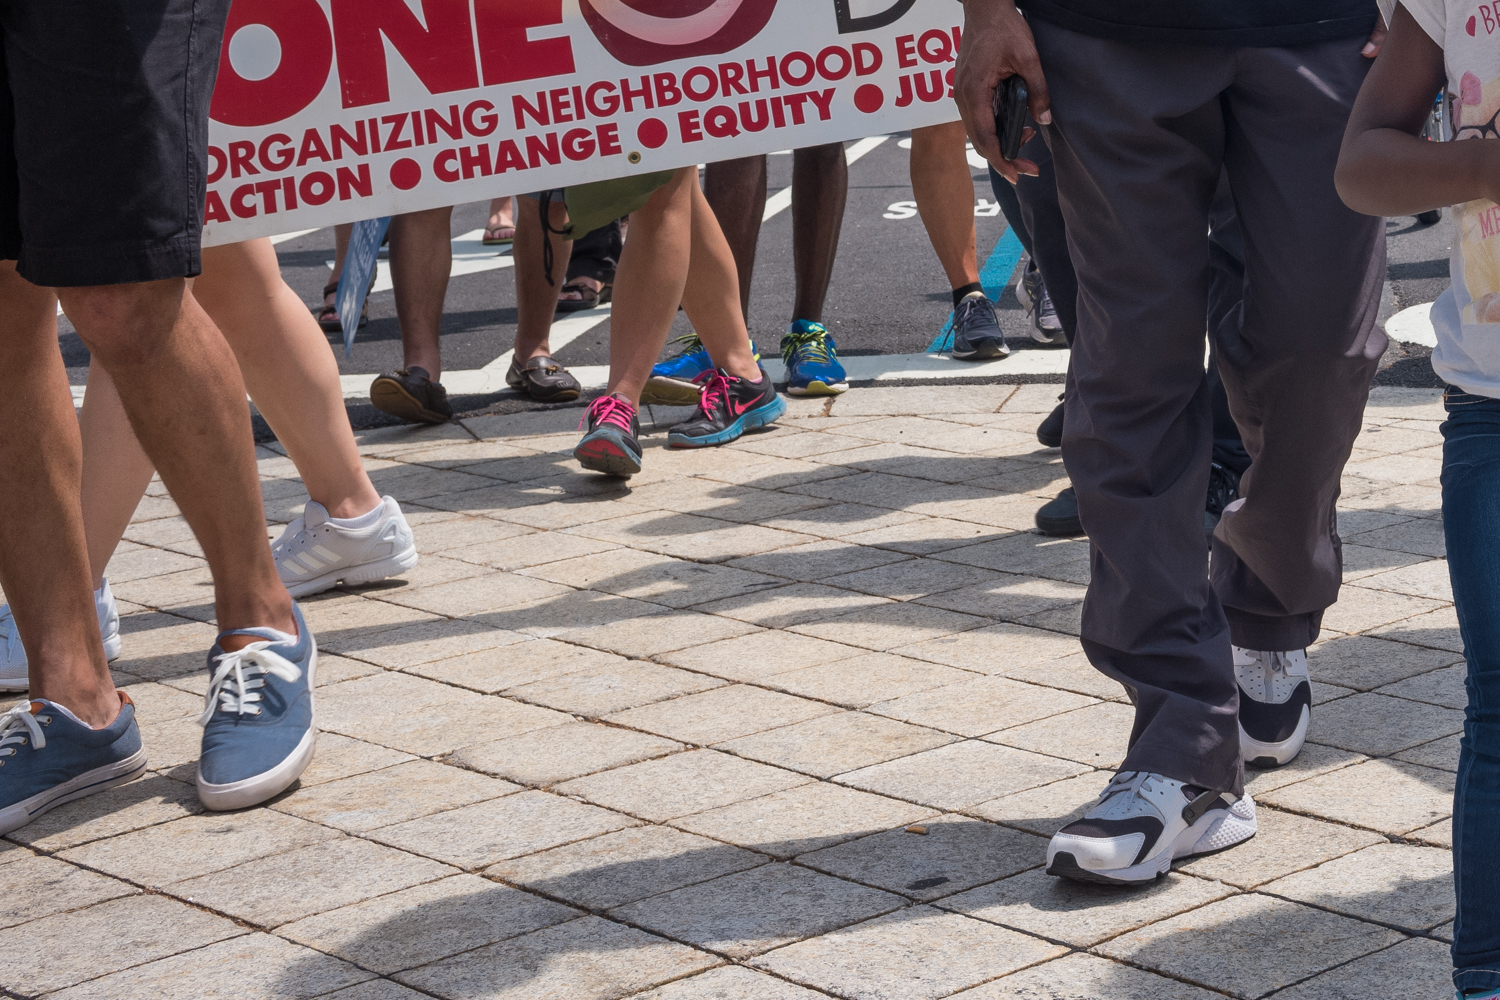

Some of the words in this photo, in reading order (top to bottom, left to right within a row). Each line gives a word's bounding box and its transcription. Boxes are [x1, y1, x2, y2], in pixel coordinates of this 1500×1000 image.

[512, 42, 883, 130] NEIGHBORHOOD
[204, 163, 373, 226] ACTION
[433, 122, 622, 182] CHANGE
[677, 87, 836, 143] EQUITY
